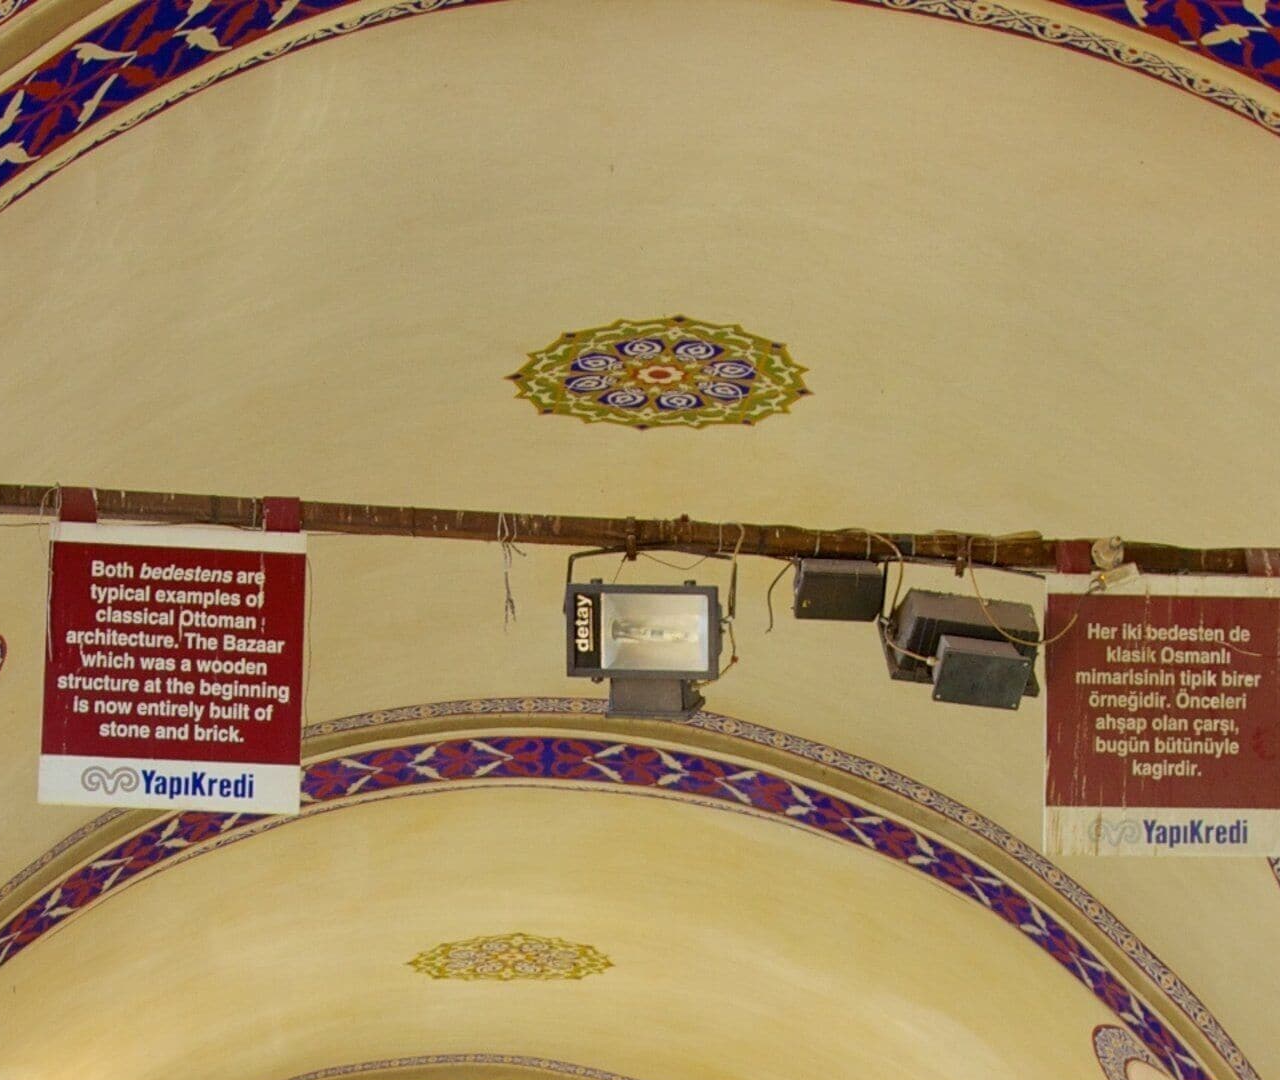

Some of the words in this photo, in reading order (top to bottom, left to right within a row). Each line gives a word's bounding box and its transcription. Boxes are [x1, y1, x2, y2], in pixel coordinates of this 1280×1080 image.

[91, 560, 134, 579] Both
[139, 562, 232, 583] bedestens
[236, 570, 266, 585] are
[90, 583, 150, 603] typical
[155, 588, 240, 608] examples
[245, 588, 264, 608] of
[95, 606, 174, 627] classical
[181, 610, 257, 630] Ottoman
[576, 593, 593, 653] detay
[66, 628, 179, 649] architecture.
[184, 632, 218, 651] The
[223, 634, 285, 653] Bazaar
[1087, 622, 1116, 640] Her
[1122, 622, 1141, 640] iki
[1146, 624, 1224, 642] bedesten
[1229, 625, 1251, 642] de
[81, 652, 135, 670] which
[139, 657, 175, 671] was
[180, 658, 191, 671] a
[196, 657, 267, 675] wooden
[1106, 645, 1156, 664] klasik
[1160, 647, 1231, 665] Osmanlı
[57, 673, 139, 692] structure
[143, 677, 161, 693] at
[165, 677, 195, 694] the
[199, 678, 289, 703] beginning
[1075, 668, 1175, 685] mimarisinin
[1180, 669, 1216, 689] tipik
[1221, 670, 1261, 687] birer
[73, 696, 89, 713] is
[94, 700, 132, 714] now
[136, 699, 204, 722] entirely
[209, 701, 249, 719] built
[254, 704, 273, 720] of
[1088, 690, 1170, 711] örneğidir.
[1175, 688, 1246, 709] Önceleri
[99, 720, 150, 738] stone
[154, 723, 188, 740] and
[194, 723, 244, 742] brick.
[1095, 713, 1147, 734] ahşap
[1151, 714, 1188, 731] olan
[1193, 718, 1238, 735] çarşı,
[1095, 735, 1149, 756] bugün
[1154, 736, 1239, 758] bütünüyle
[1132, 759, 1202, 780] kagirdir.
[141, 769, 256, 799] YapıKredi
[1142, 819, 1248, 848] YapıKredi
